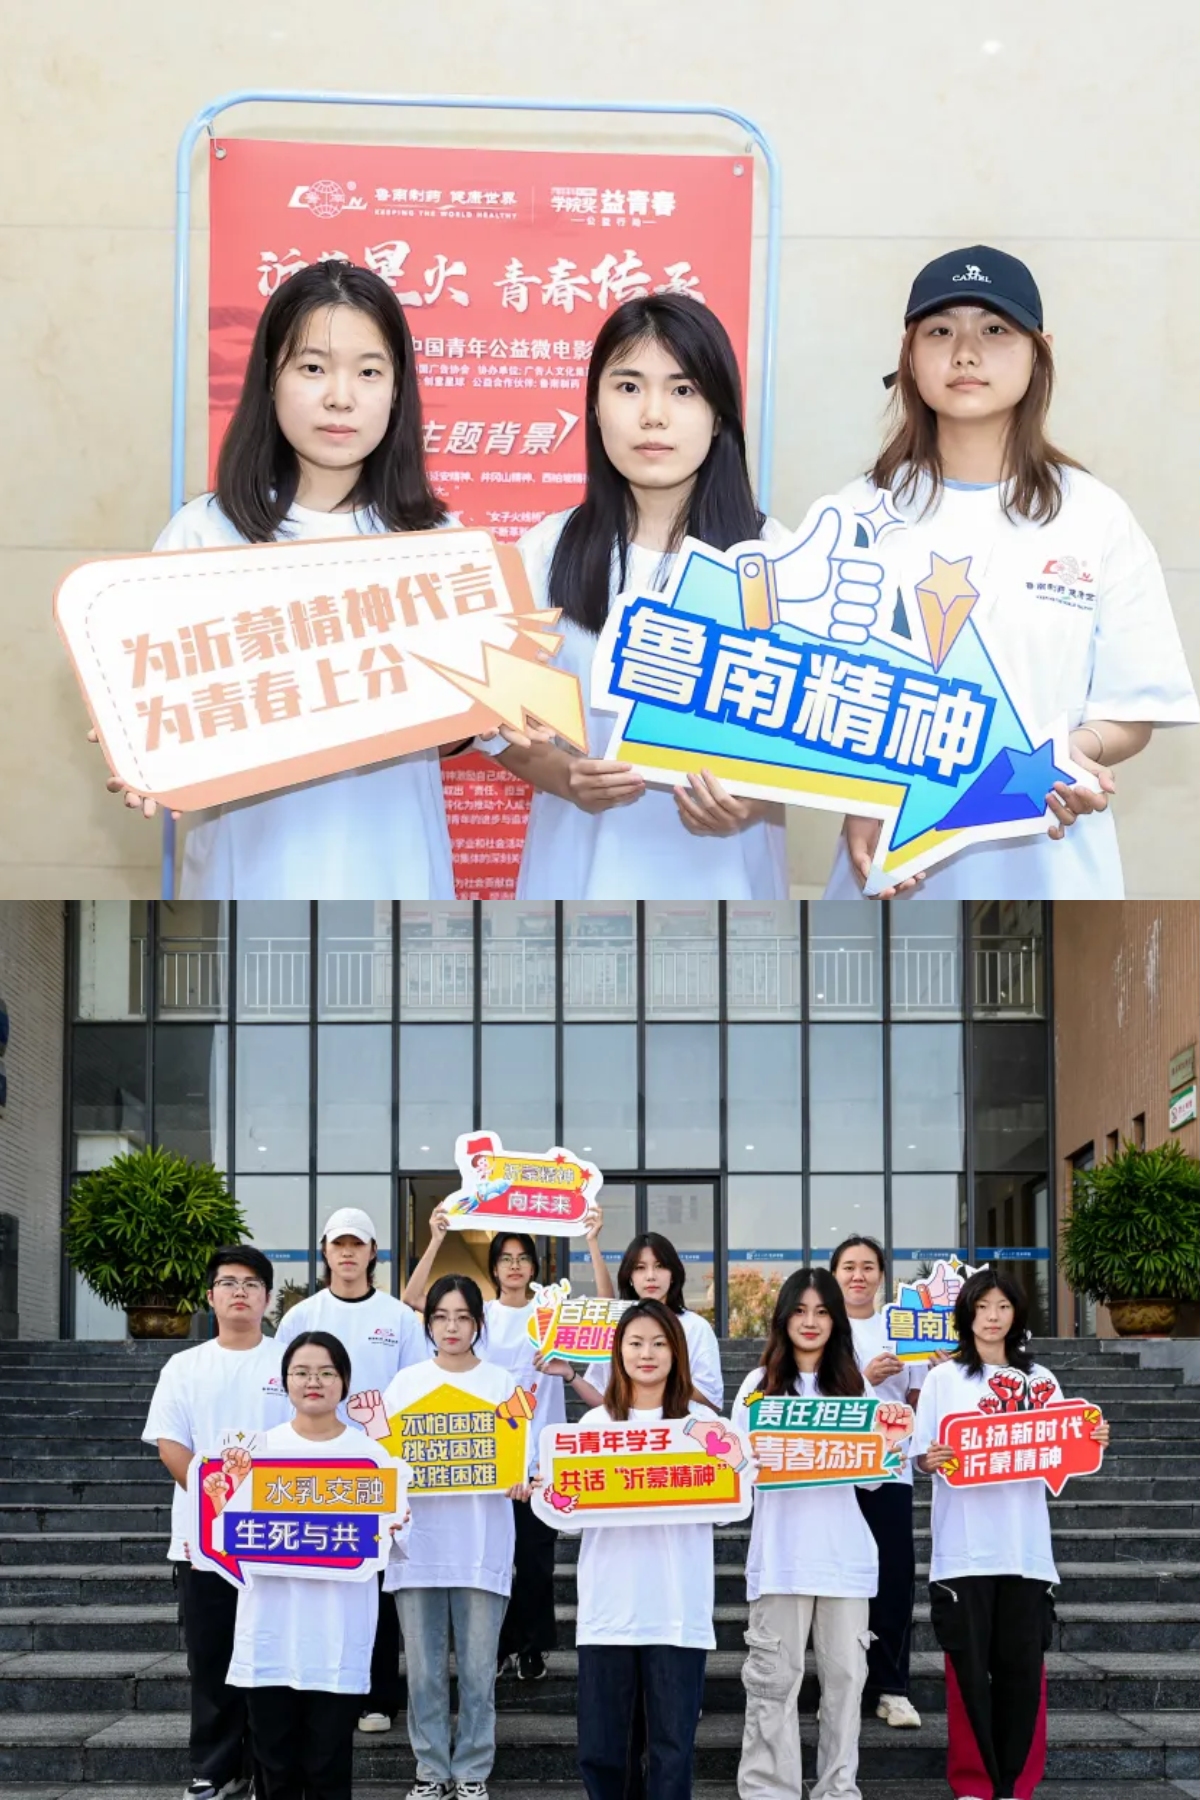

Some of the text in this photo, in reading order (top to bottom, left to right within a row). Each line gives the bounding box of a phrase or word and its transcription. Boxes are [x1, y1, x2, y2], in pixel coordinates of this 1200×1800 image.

[600, 189, 676, 216] 益青春
[952, 274, 992, 284] CAMEL
[422, 420, 558, 455] 主题背景
[122, 562, 498, 688] 为沂蒙精神代言
[136, 643, 408, 752] 为青春上分
[617, 606, 987, 777] 鲁南精神
[507, 1191, 572, 1215] 向未来
[402, 1412, 495, 1436] 不怕困难
[757, 1400, 867, 1427] 责任担当
[555, 1428, 672, 1455] 与青年学子
[960, 1417, 1083, 1450] 弘扬新时代
[402, 1437, 496, 1462] 挑战困难
[756, 1436, 876, 1472] 青春扬沂
[963, 1447, 1062, 1477] 沂蒙精神
[266, 1477, 385, 1506] 水乳交融
[235, 1519, 360, 1553] 生死与共
